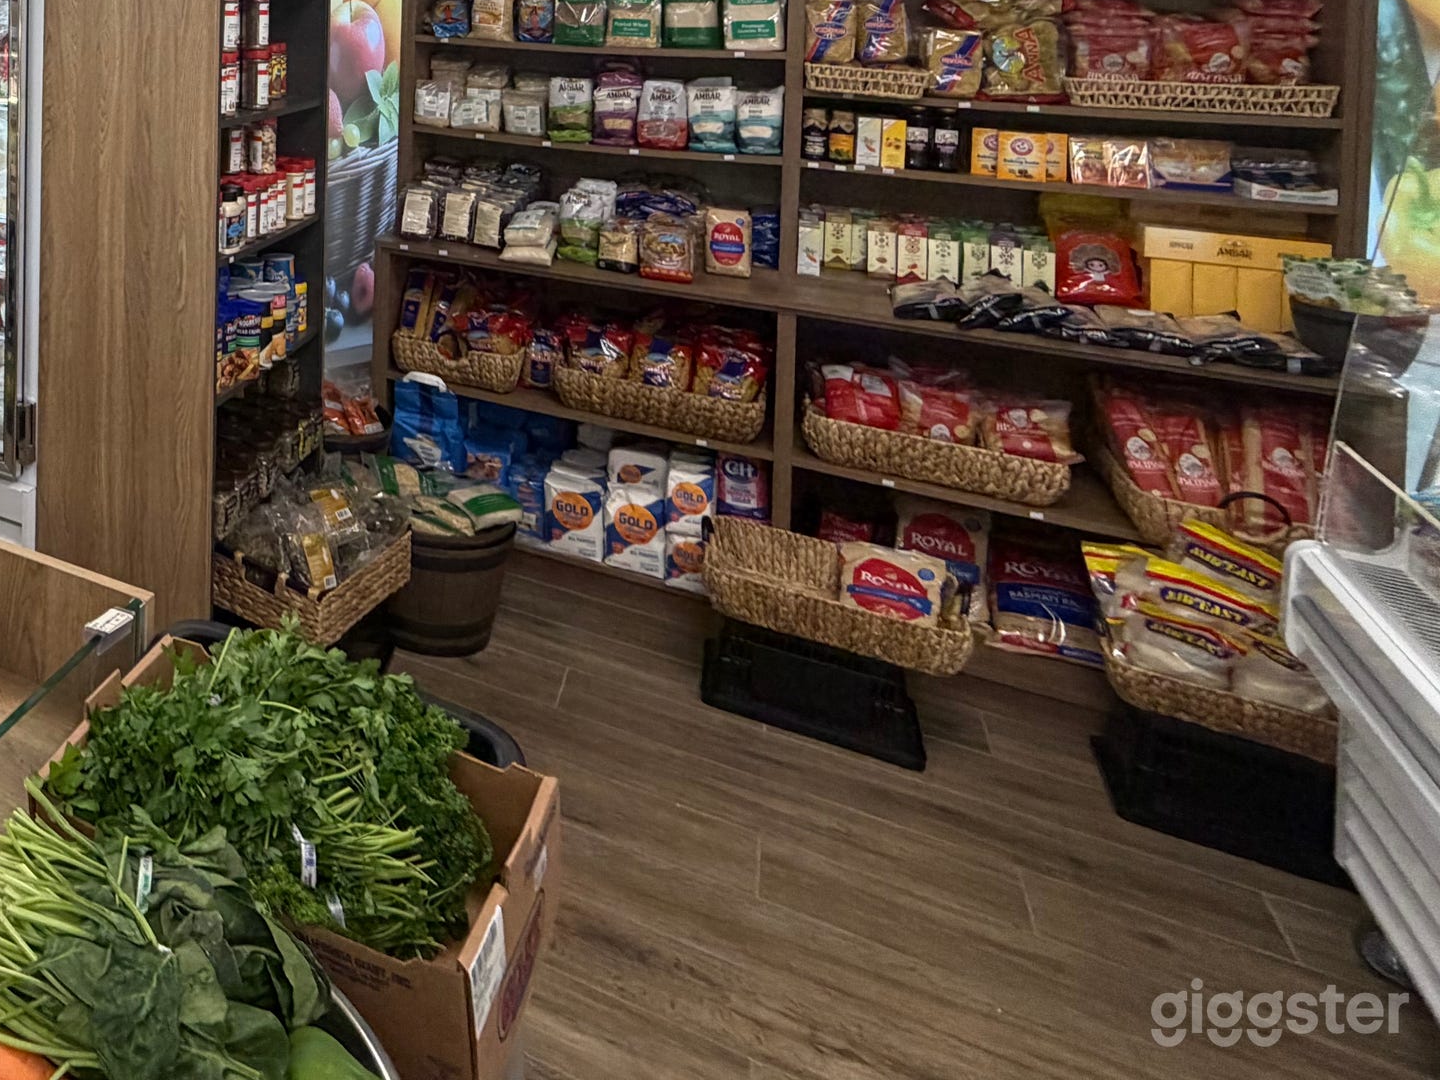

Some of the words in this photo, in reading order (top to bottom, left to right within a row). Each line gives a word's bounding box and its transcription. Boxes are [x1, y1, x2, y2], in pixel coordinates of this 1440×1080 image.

[693, 92, 722, 102] AMBAR
[742, 96, 771, 107] AMBAR
[713, 232, 741, 242] ROYAL
[1216, 246, 1253, 260] AMBAR
[675, 489, 704, 504] GOLD
[555, 499, 589, 518] GOLD
[618, 512, 654, 530] GOLD
[911, 531, 968, 557] ROYAL
[861, 570, 920, 594] ROYAL
